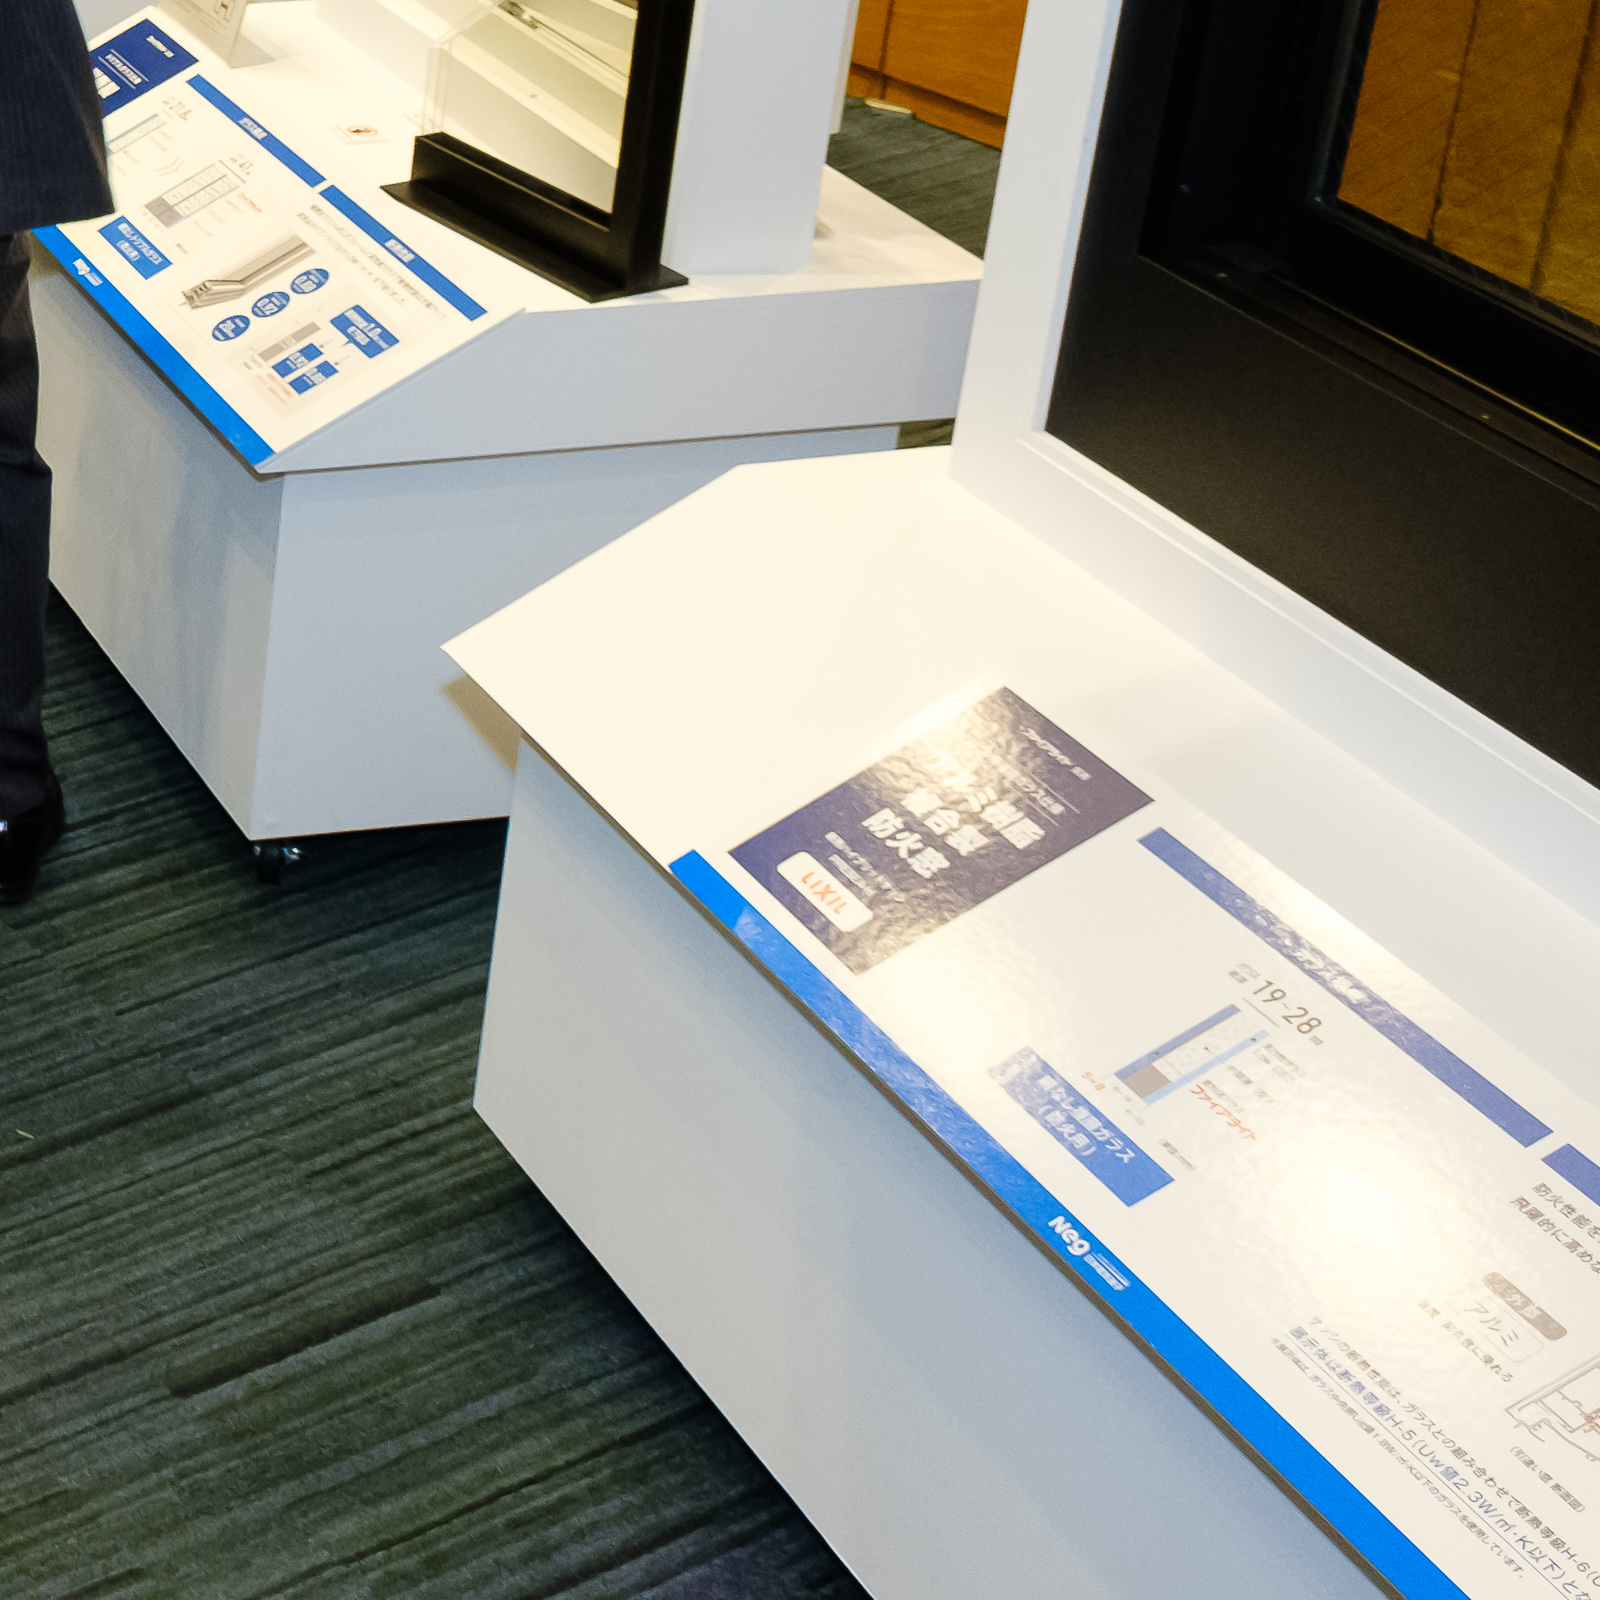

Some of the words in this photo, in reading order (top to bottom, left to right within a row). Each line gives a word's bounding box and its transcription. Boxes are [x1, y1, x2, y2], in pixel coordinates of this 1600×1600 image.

[861, 808, 950, 880] 防火窓
[902, 789, 990, 857] 複合製
[801, 871, 849, 915] LIXIL
[1190, 1084, 1257, 1141] ファイアライト
[1048, 1214, 1091, 1257] Neg
[1465, 1300, 1520, 1347] アルミ
